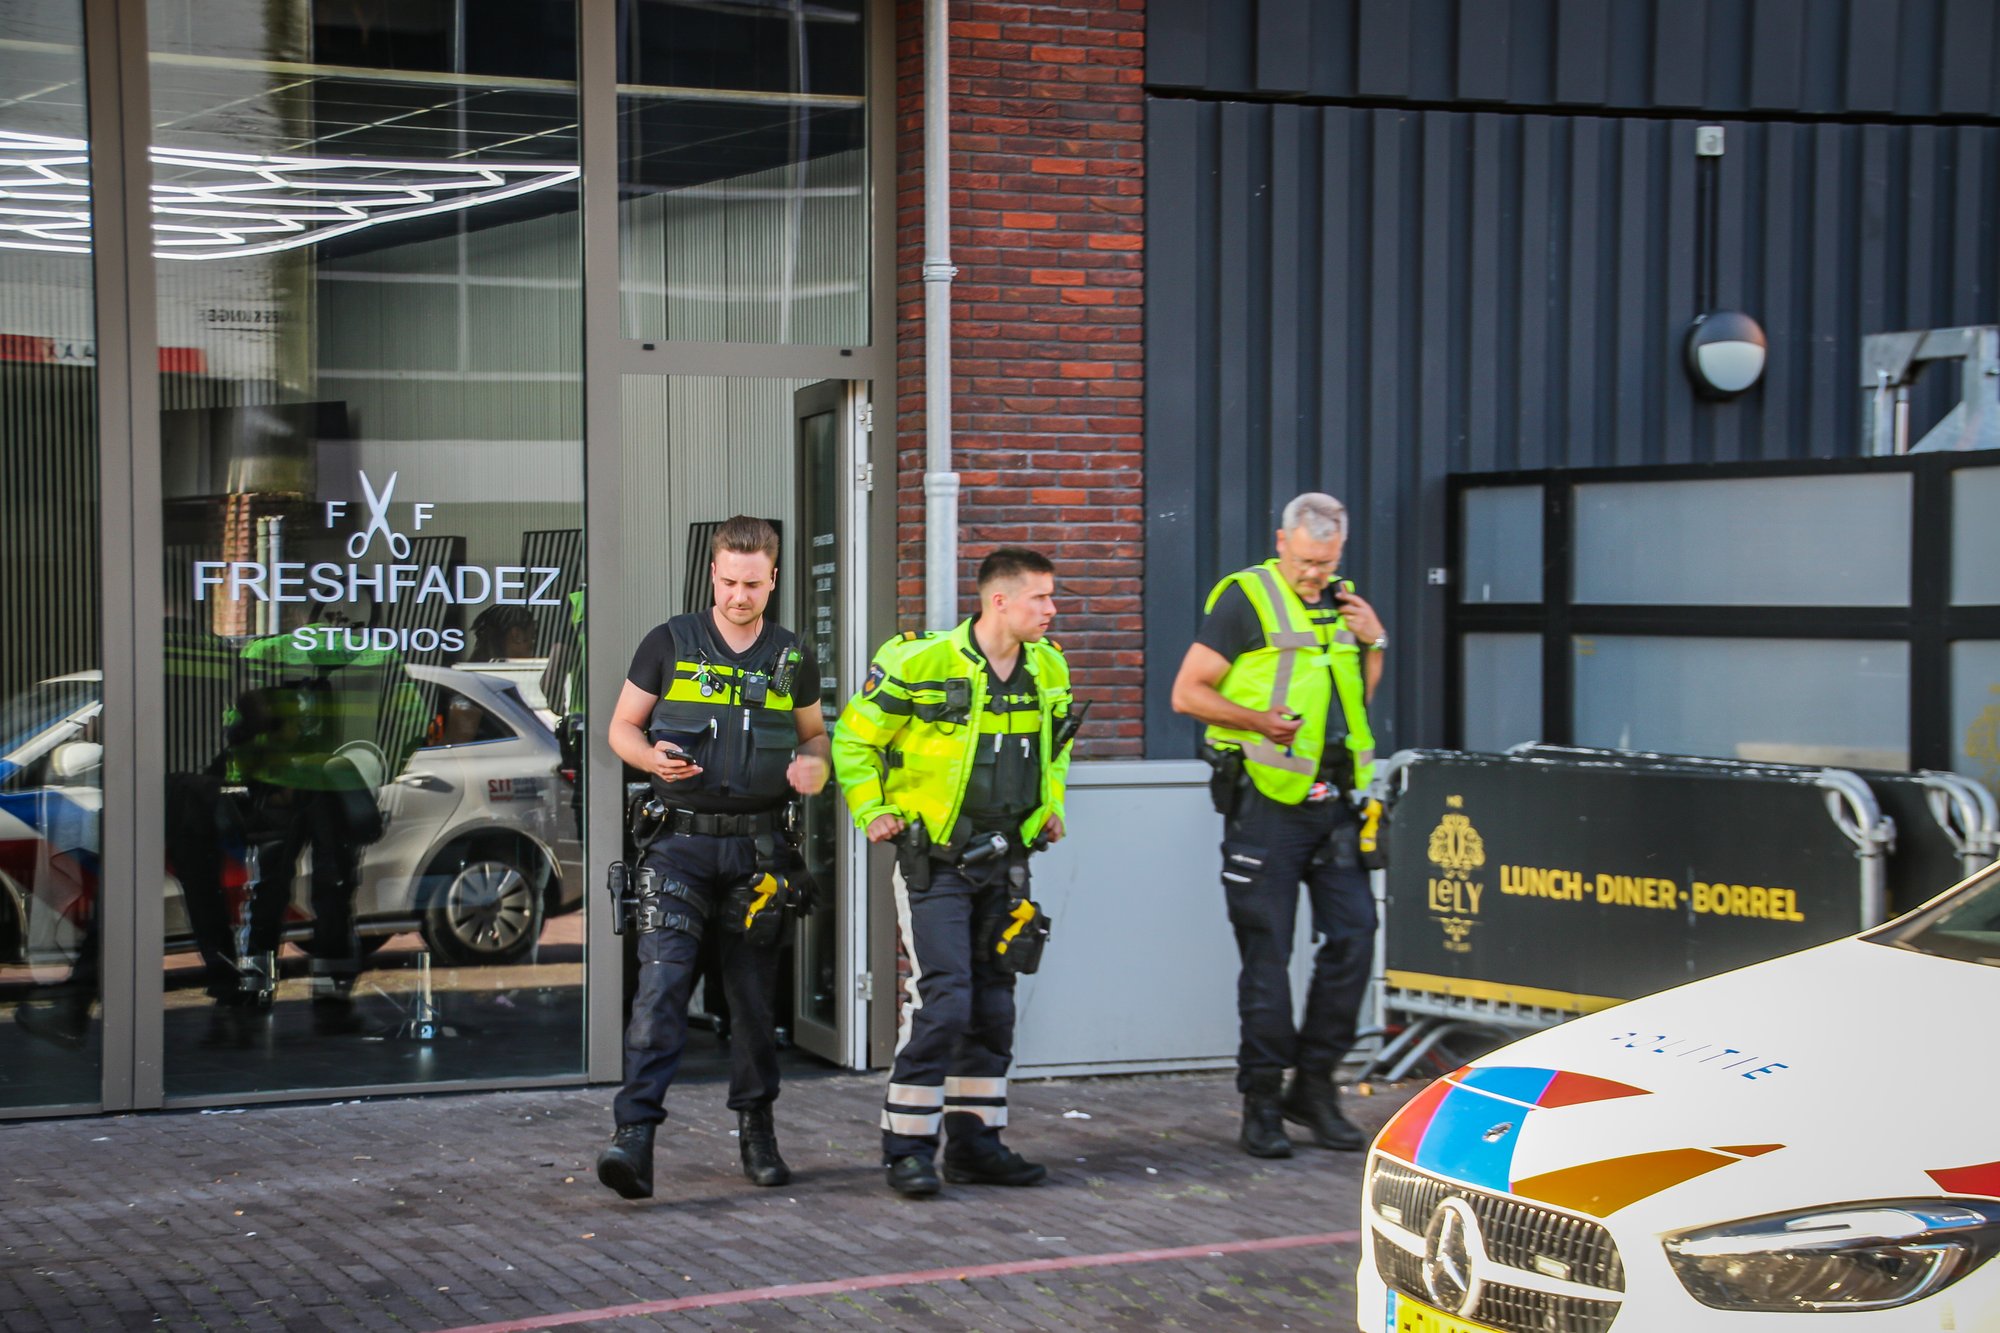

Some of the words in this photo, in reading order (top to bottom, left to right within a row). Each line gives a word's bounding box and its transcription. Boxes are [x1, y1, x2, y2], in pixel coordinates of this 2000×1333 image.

[325, 501, 347, 528] F
[414, 503, 435, 530] F
[194, 561, 561, 606] FRESHFADEZ
[292, 627, 465, 652] STUDIOS
